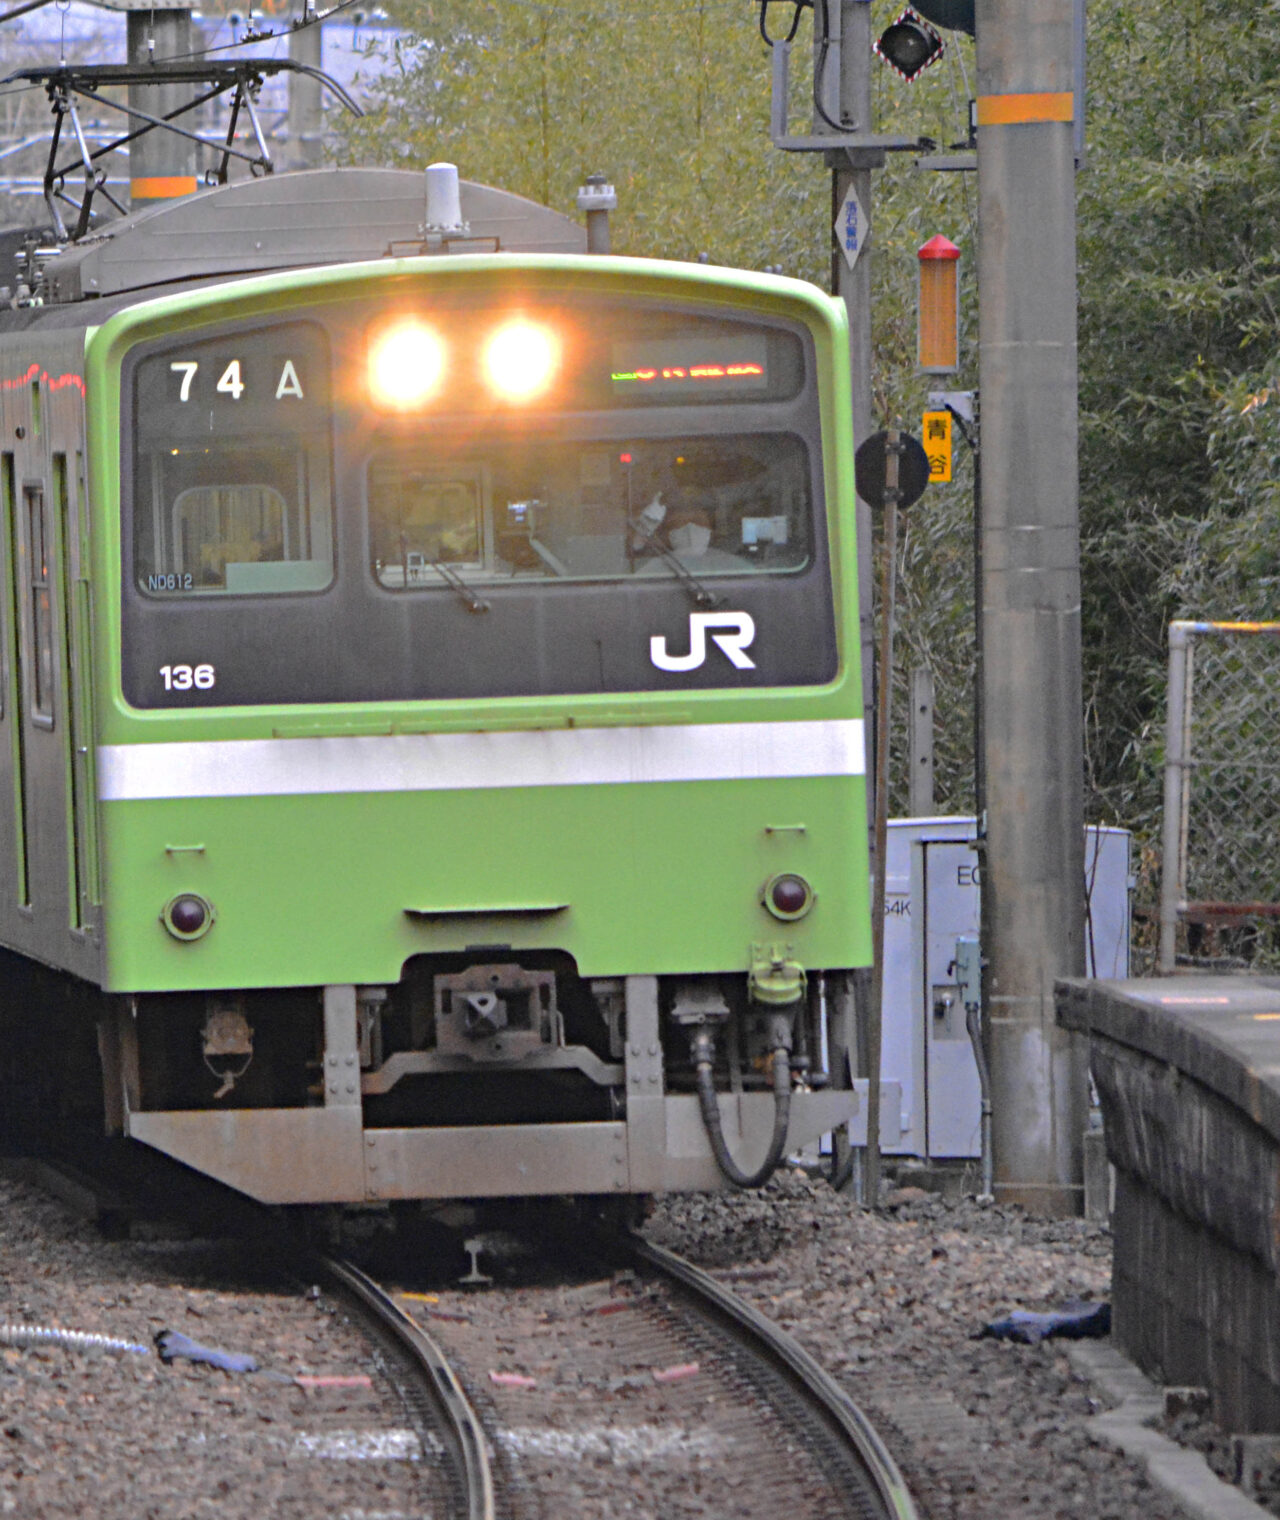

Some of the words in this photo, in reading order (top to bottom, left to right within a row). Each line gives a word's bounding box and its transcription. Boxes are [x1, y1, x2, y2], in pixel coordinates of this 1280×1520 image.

[927, 419, 947, 475] 青谷
[148, 572, 193, 591] ND612
[650, 611, 756, 672] JR
[160, 664, 215, 691] 136
